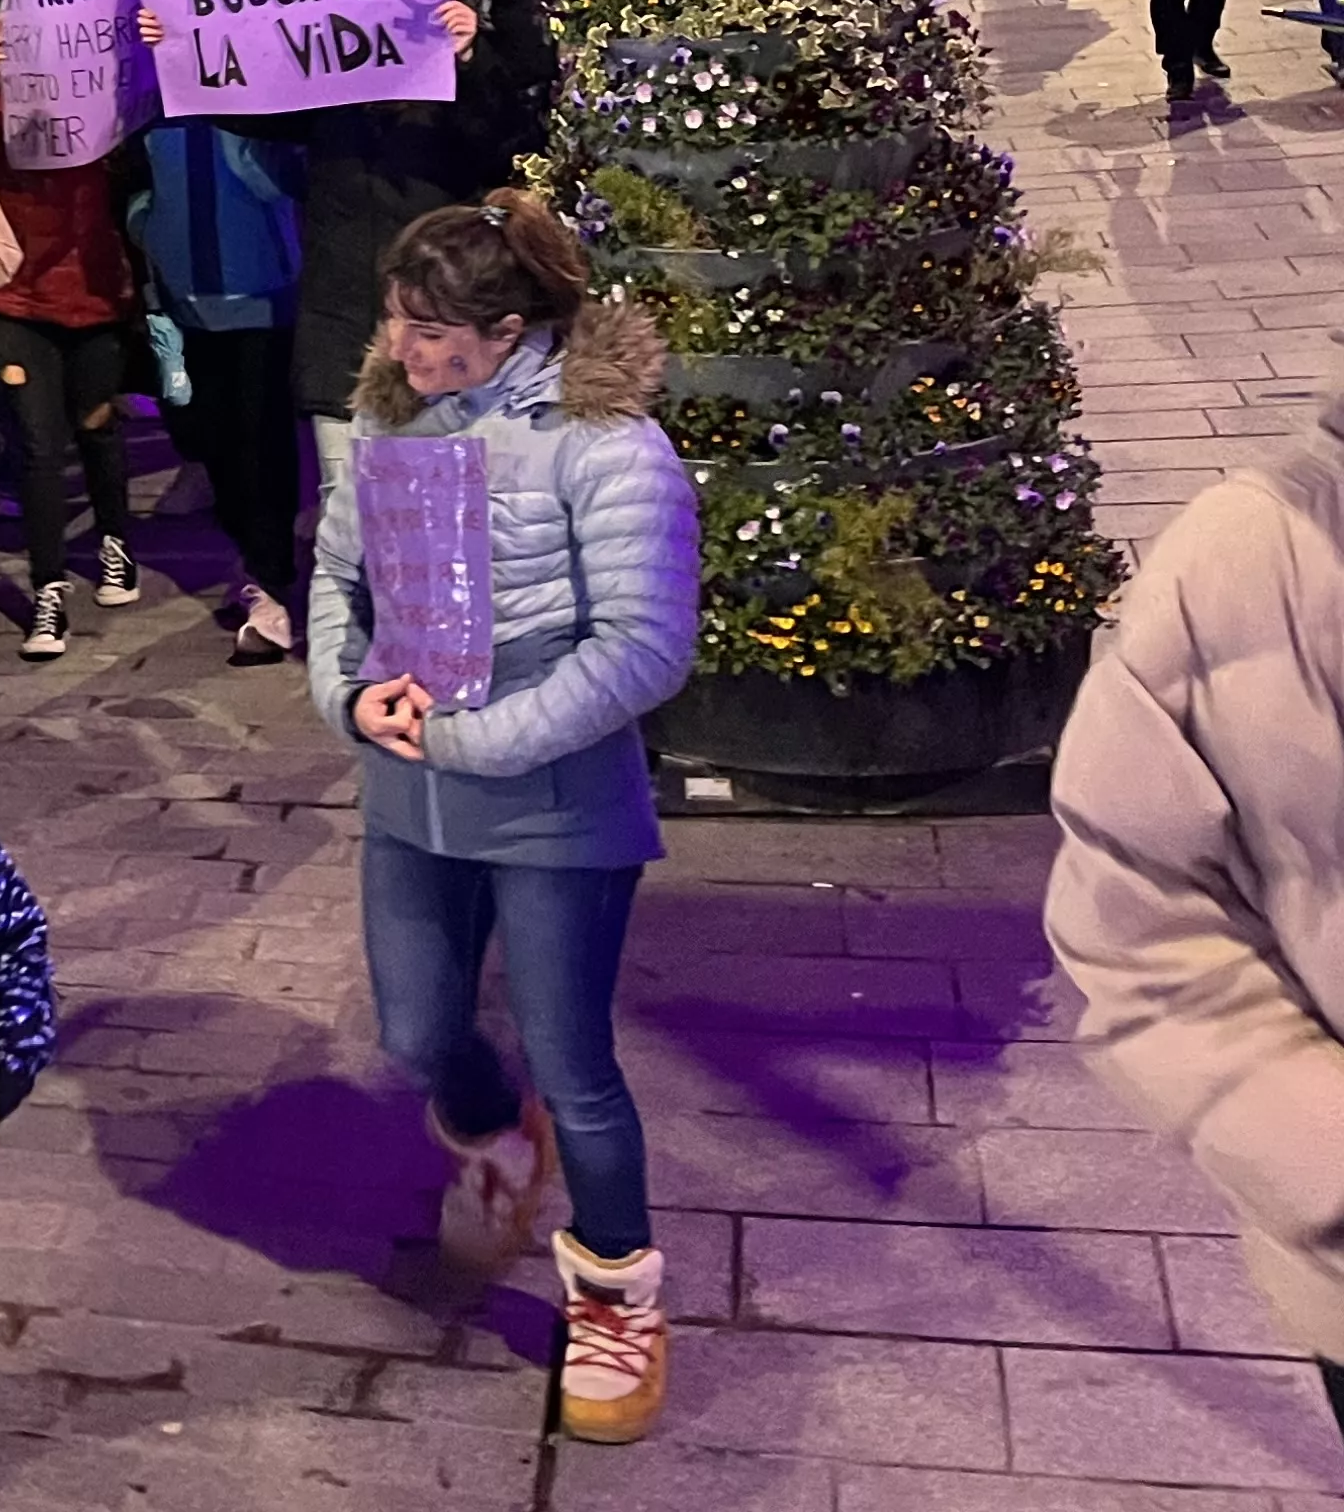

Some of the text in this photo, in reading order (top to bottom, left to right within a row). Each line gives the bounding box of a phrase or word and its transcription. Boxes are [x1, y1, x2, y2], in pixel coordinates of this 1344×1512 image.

[192, 13, 405, 89] LA VIDA
[70, 66, 105, 100] EN
